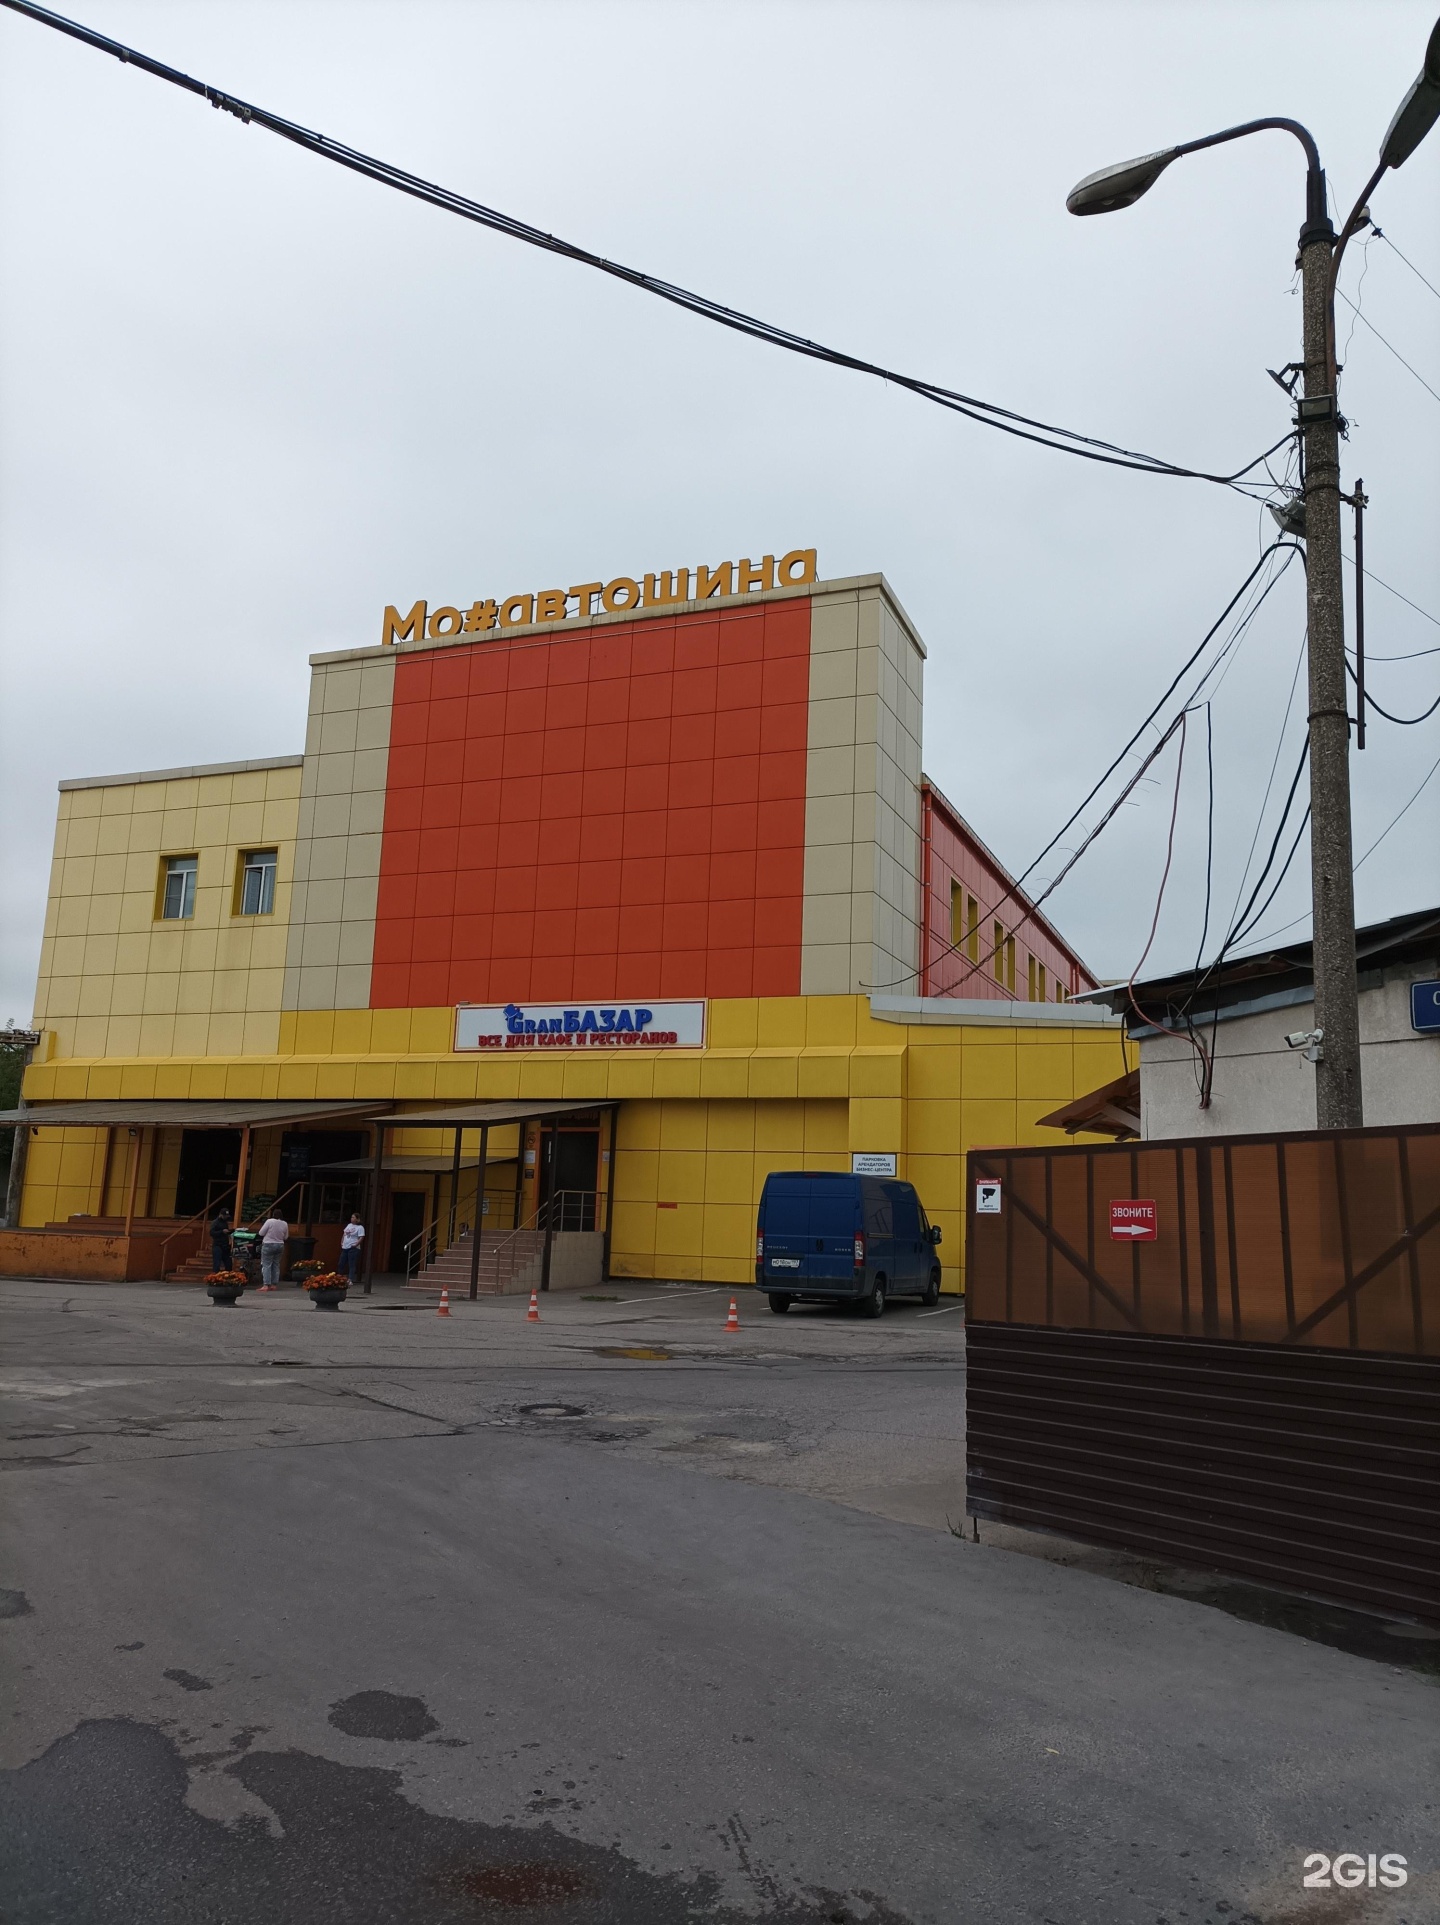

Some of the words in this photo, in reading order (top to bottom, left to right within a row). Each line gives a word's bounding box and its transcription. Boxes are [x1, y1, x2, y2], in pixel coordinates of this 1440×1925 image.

[478, 1034, 502, 1047] ВСЕ
[505, 1033, 534, 1048] ДЛЯ
[538, 1033, 572, 1046] КАФЕ
[576, 1033, 586, 1045] И
[589, 1031, 678, 1045] РЕСТОРАНОВ
[1112, 1207, 1153, 1218] ЗВОНИТЕ
